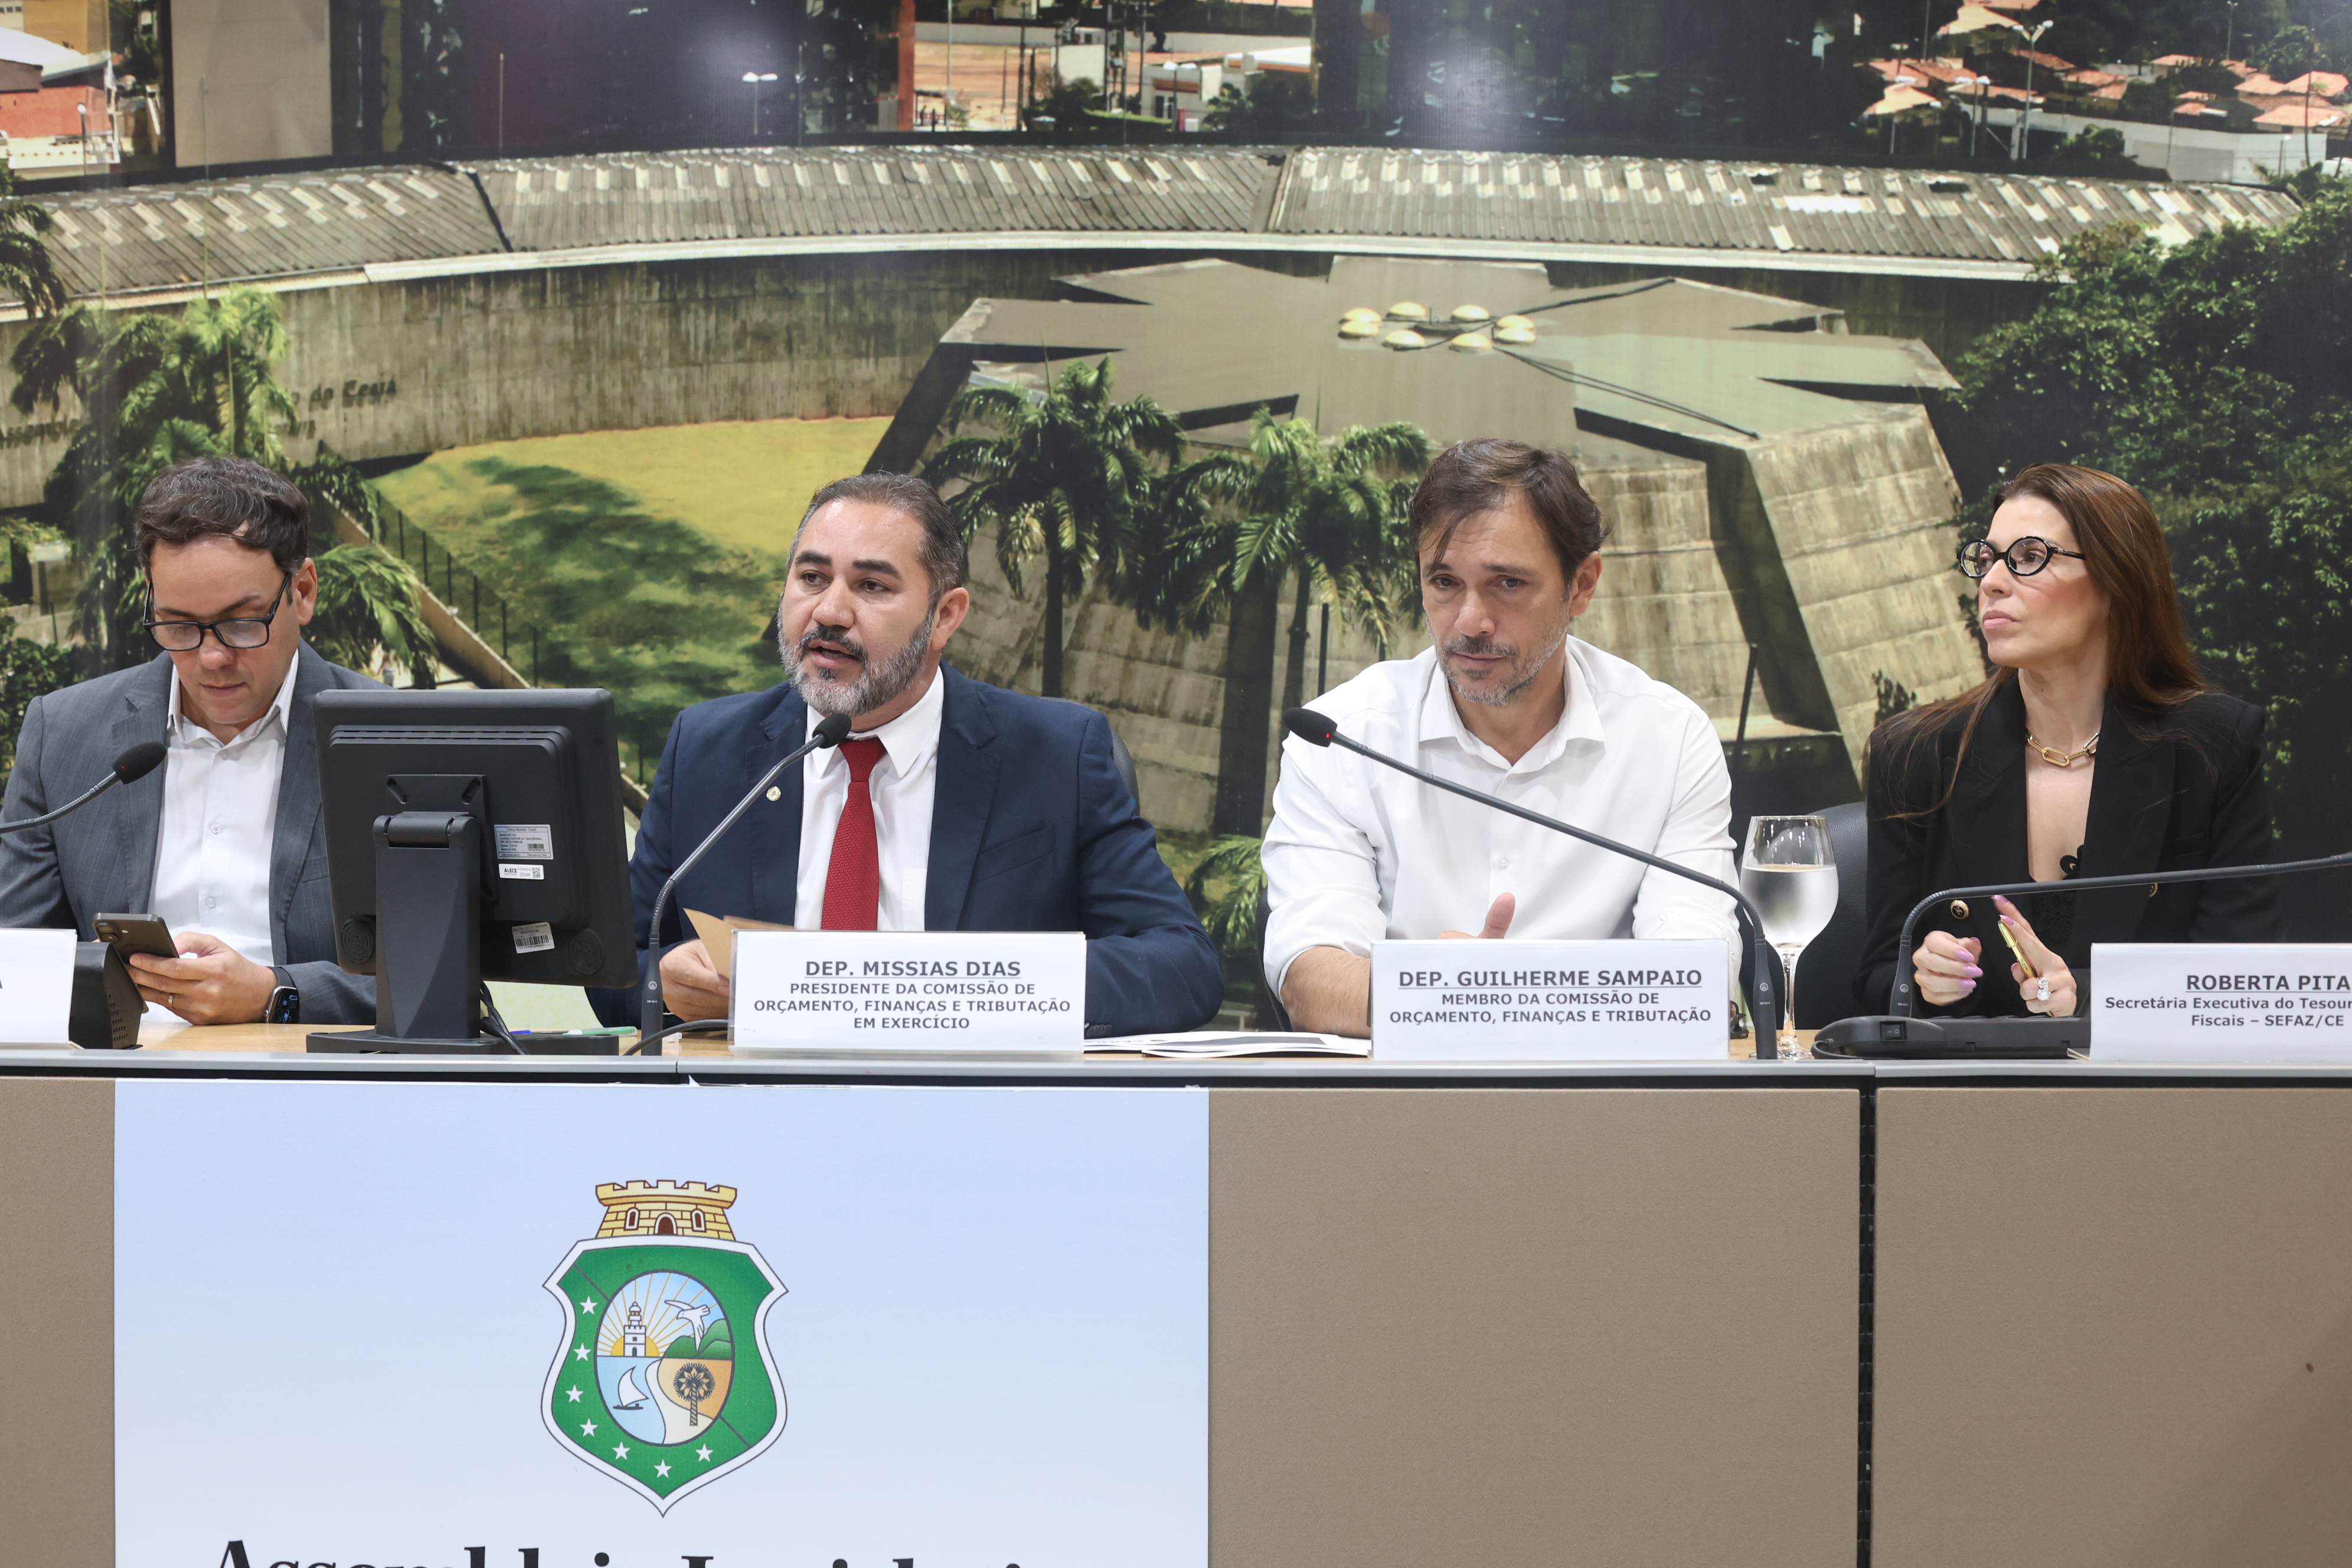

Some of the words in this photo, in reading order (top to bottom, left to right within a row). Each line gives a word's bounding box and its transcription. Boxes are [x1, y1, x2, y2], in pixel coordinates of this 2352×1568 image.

[806, 961, 854, 976] DEP.
[863, 961, 958, 976] MISSIAS
[966, 961, 1020, 976] DIAS
[1400, 971, 1448, 986] DEP.
[1457, 971, 1589, 986] GUILHERME
[1598, 969, 1702, 986] SAMPAIO
[2187, 975, 2290, 990] ROBERTA
[2298, 975, 2351, 990] PITA
[790, 983, 890, 994] PRESIDENTE
[896, 984, 917, 994] DA
[923, 981, 1008, 994] COMISSÃO
[1015, 984, 1035, 994] DE
[1442, 994, 1512, 1005] MEMBRO
[1518, 994, 1540, 1005] DA
[1546, 989, 1632, 1005] COMISSÃO
[1639, 993, 1659, 1004] DE
[2105, 996, 2187, 1009] Secretária
[2193, 997, 2269, 1009] Executiva
[2275, 997, 2294, 1009] do
[754, 1000, 858, 1014] ORÇAMENTO,
[865, 1001, 946, 1014] FINANÇAS
[953, 1001, 961, 1011] E
[966, 998, 1070, 1014] TRIBUTAÇÃO
[854, 1018, 875, 1028] EM
[882, 1014, 969, 1028] EXERCÍCIO
[1390, 1011, 1496, 1025] ORÇAMENTO,
[1503, 1011, 1586, 1024] FINANÇAS
[1592, 1011, 1600, 1021] E
[1606, 1007, 1711, 1024] TRIBUTAÇÃO
[2191, 1014, 2245, 1026] Fiscais
[2265, 1015, 2344, 1028] SEFAZ/CE
